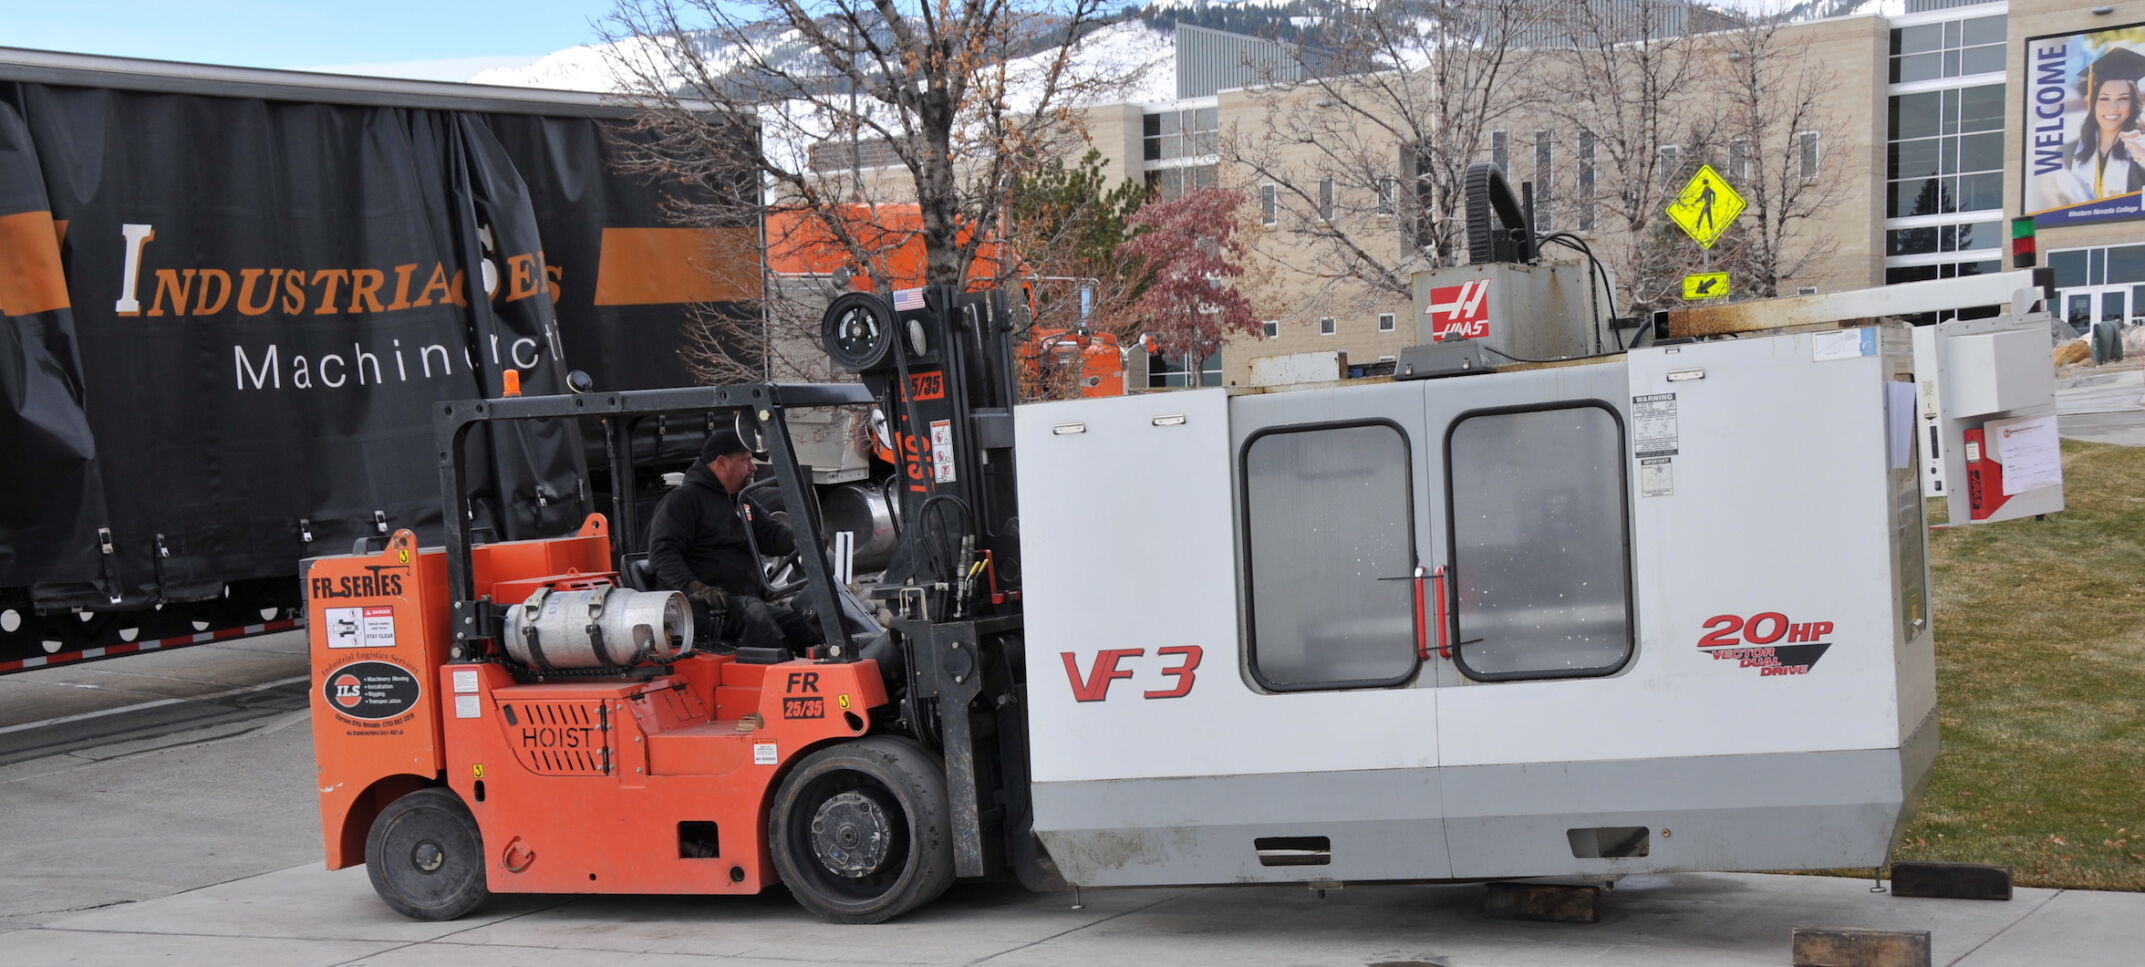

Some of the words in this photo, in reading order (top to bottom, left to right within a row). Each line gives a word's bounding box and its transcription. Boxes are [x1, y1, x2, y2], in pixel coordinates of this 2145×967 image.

[2034, 44, 2067, 176] WELCOME
[1433, 319, 1489, 338] HAAS
[1636, 394, 1673, 403] WARNING
[1711, 647, 1775, 660] VECTOR
[1740, 656, 1782, 668] DUAL
[321, 653, 354, 676] Industrial
[356, 651, 388, 660] Logistics
[391, 654, 419, 674] Services
[1760, 664, 1809, 676] DRIVE
[336, 685, 361, 697] ILS
[786, 672, 819, 693] FR
[785, 700, 823, 717] 25/35
[522, 727, 594, 748] HOIST
